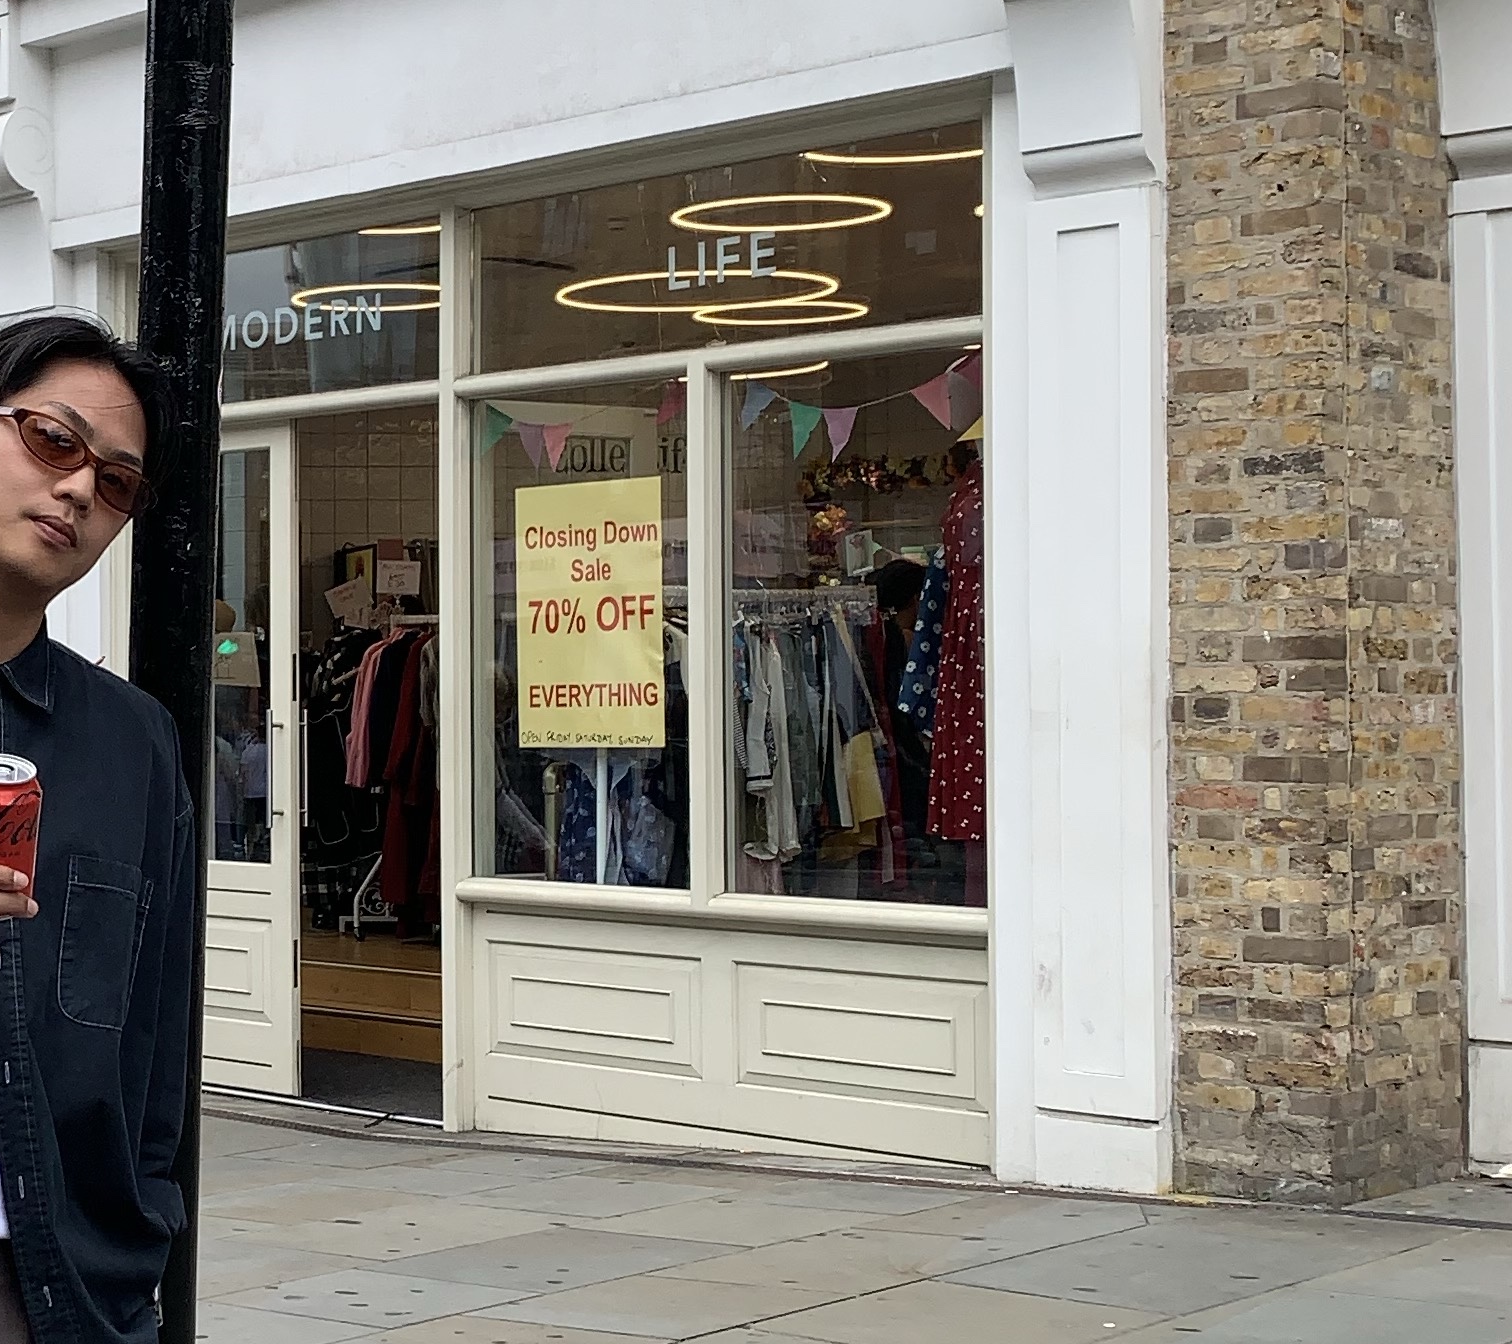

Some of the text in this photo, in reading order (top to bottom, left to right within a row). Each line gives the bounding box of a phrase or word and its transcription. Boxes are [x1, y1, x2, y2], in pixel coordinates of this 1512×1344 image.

[668, 231, 777, 291] LIFE
[525, 521, 658, 552] Closing Down
[570, 558, 612, 582] Sale
[528, 594, 656, 635] 70% OFF
[529, 682, 659, 709] EVERYTHING
[521, 730, 542, 745] OPEN
[618, 734, 654, 747] SUNDAY
